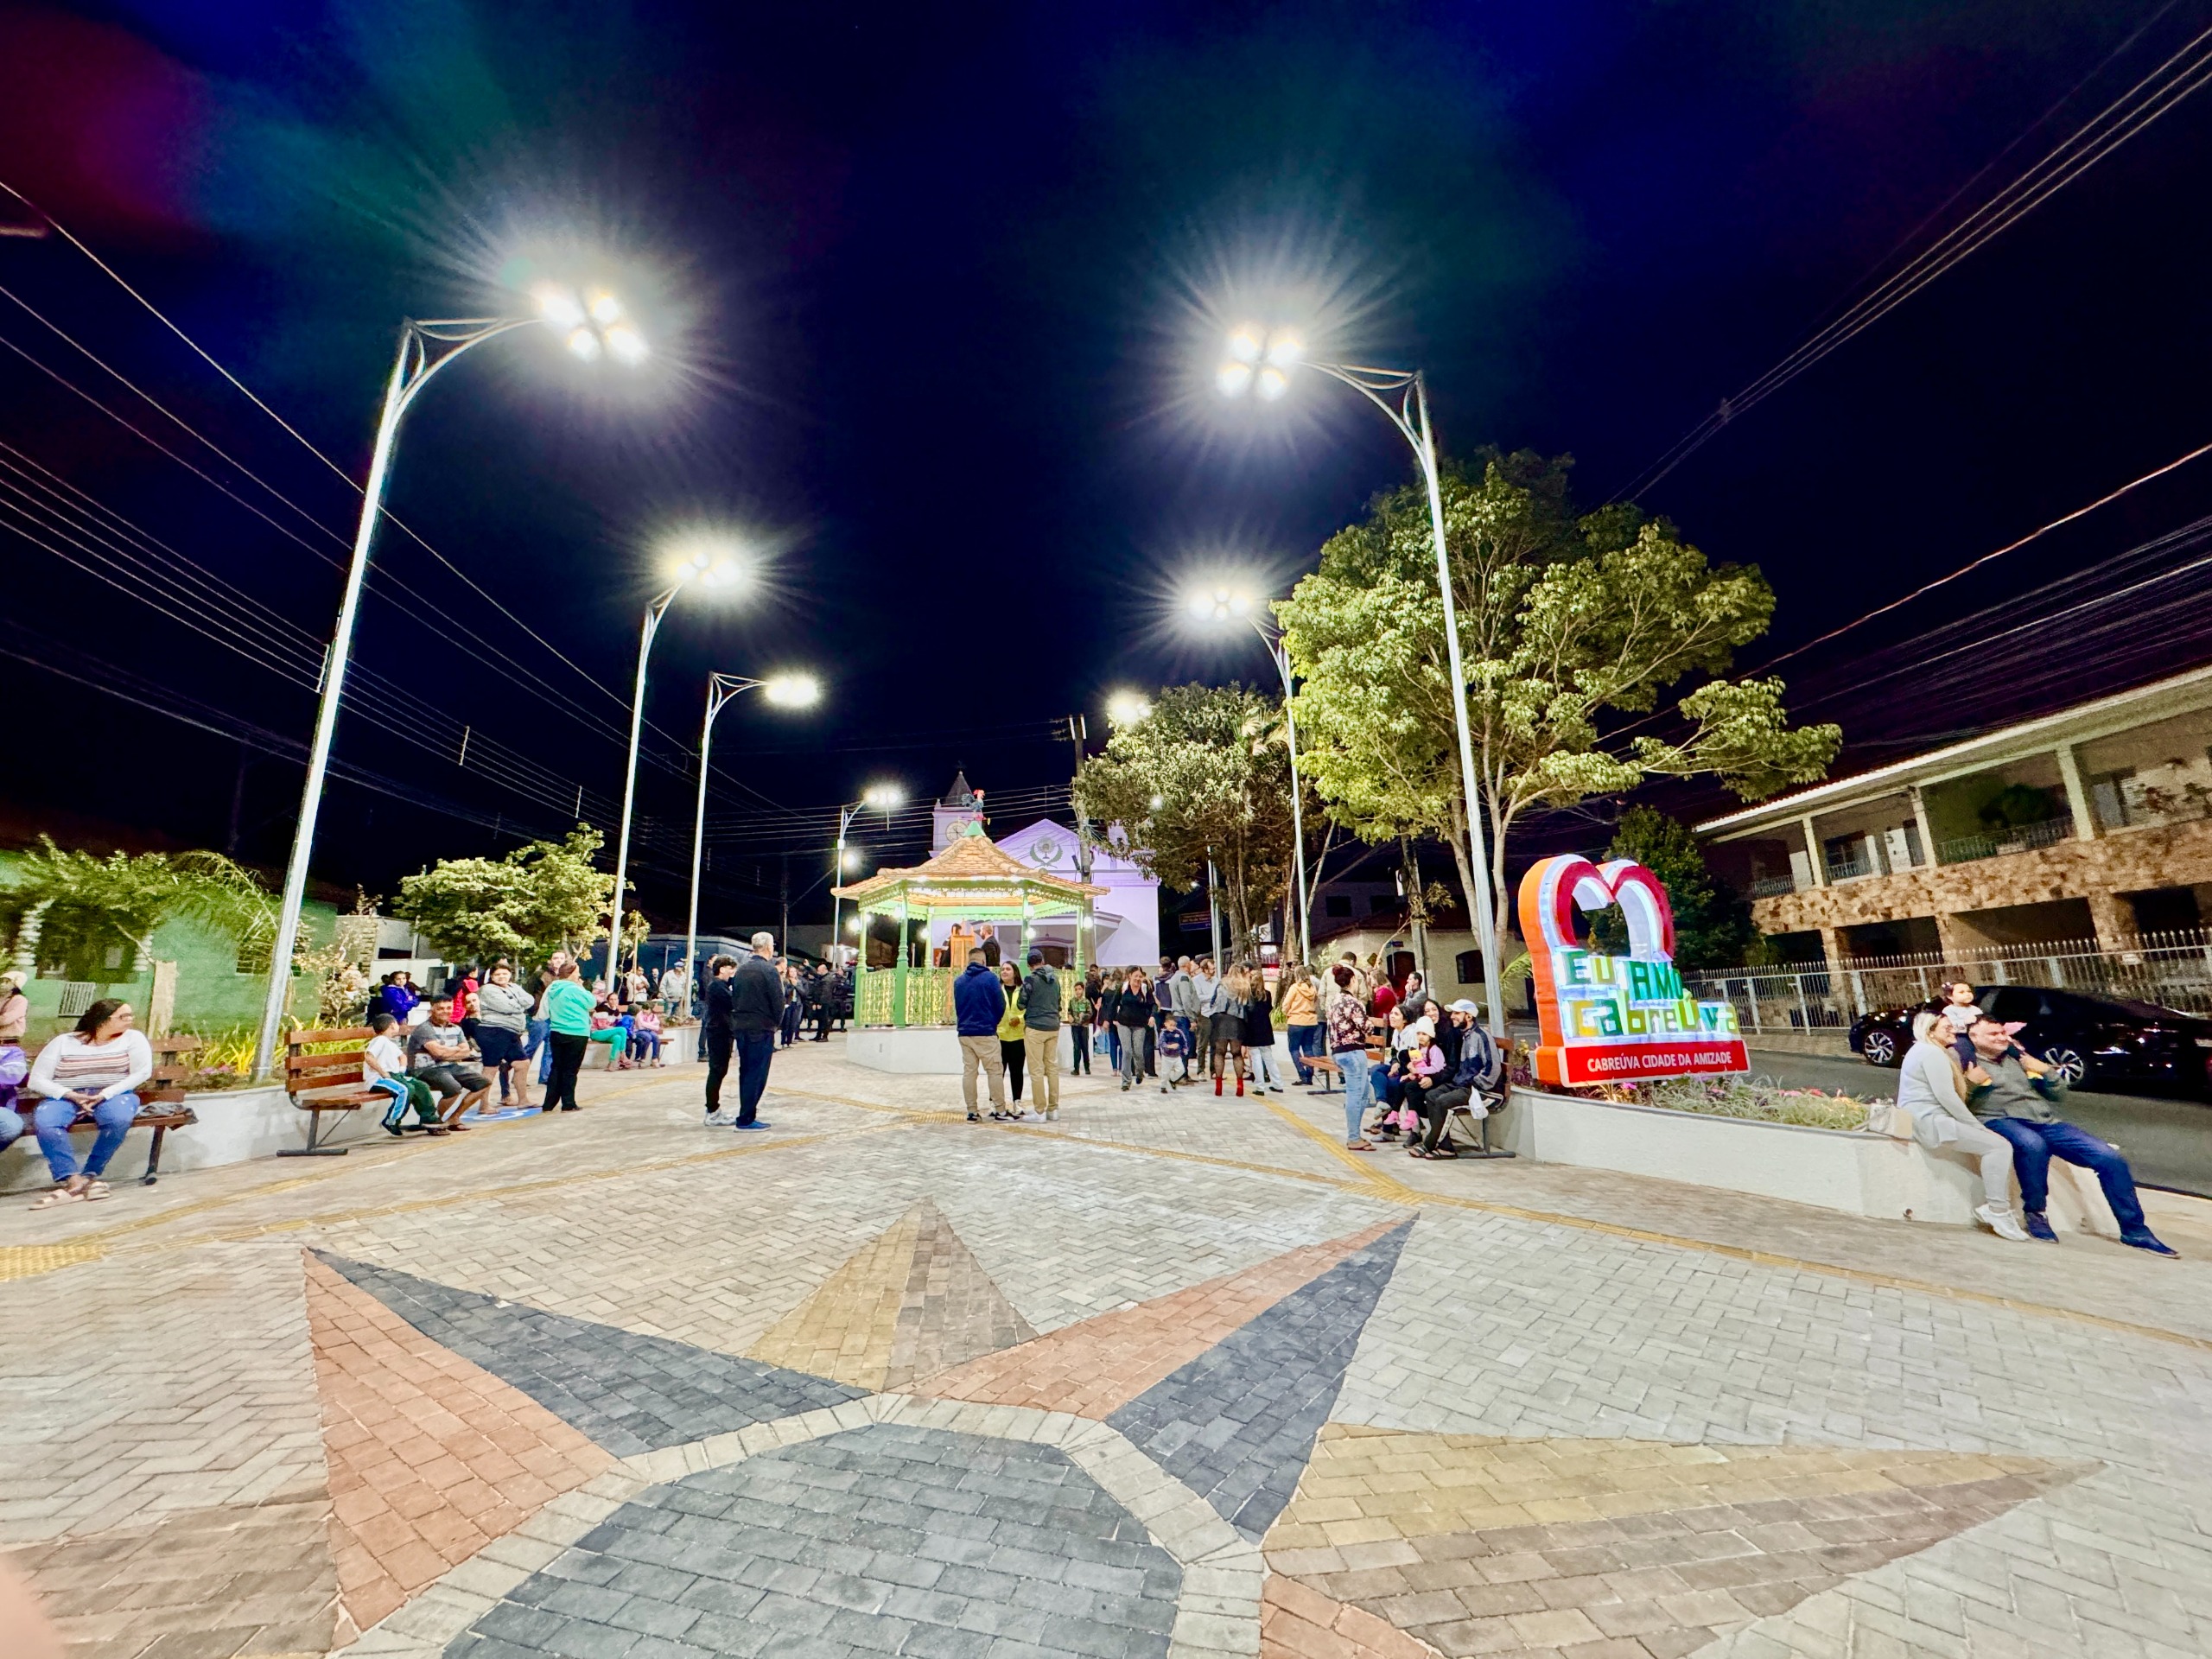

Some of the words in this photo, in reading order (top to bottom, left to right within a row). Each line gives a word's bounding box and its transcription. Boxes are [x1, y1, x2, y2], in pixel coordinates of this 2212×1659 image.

[1565, 950, 1616, 984] EU
[1624, 960, 1684, 1000] AMO
[1587, 1052, 1640, 1072] CABREÚVA
[1642, 1053, 1676, 1068] CIDADE
[1678, 1052, 1692, 1066] DA
[1694, 1051, 1732, 1065] AMIZADE
